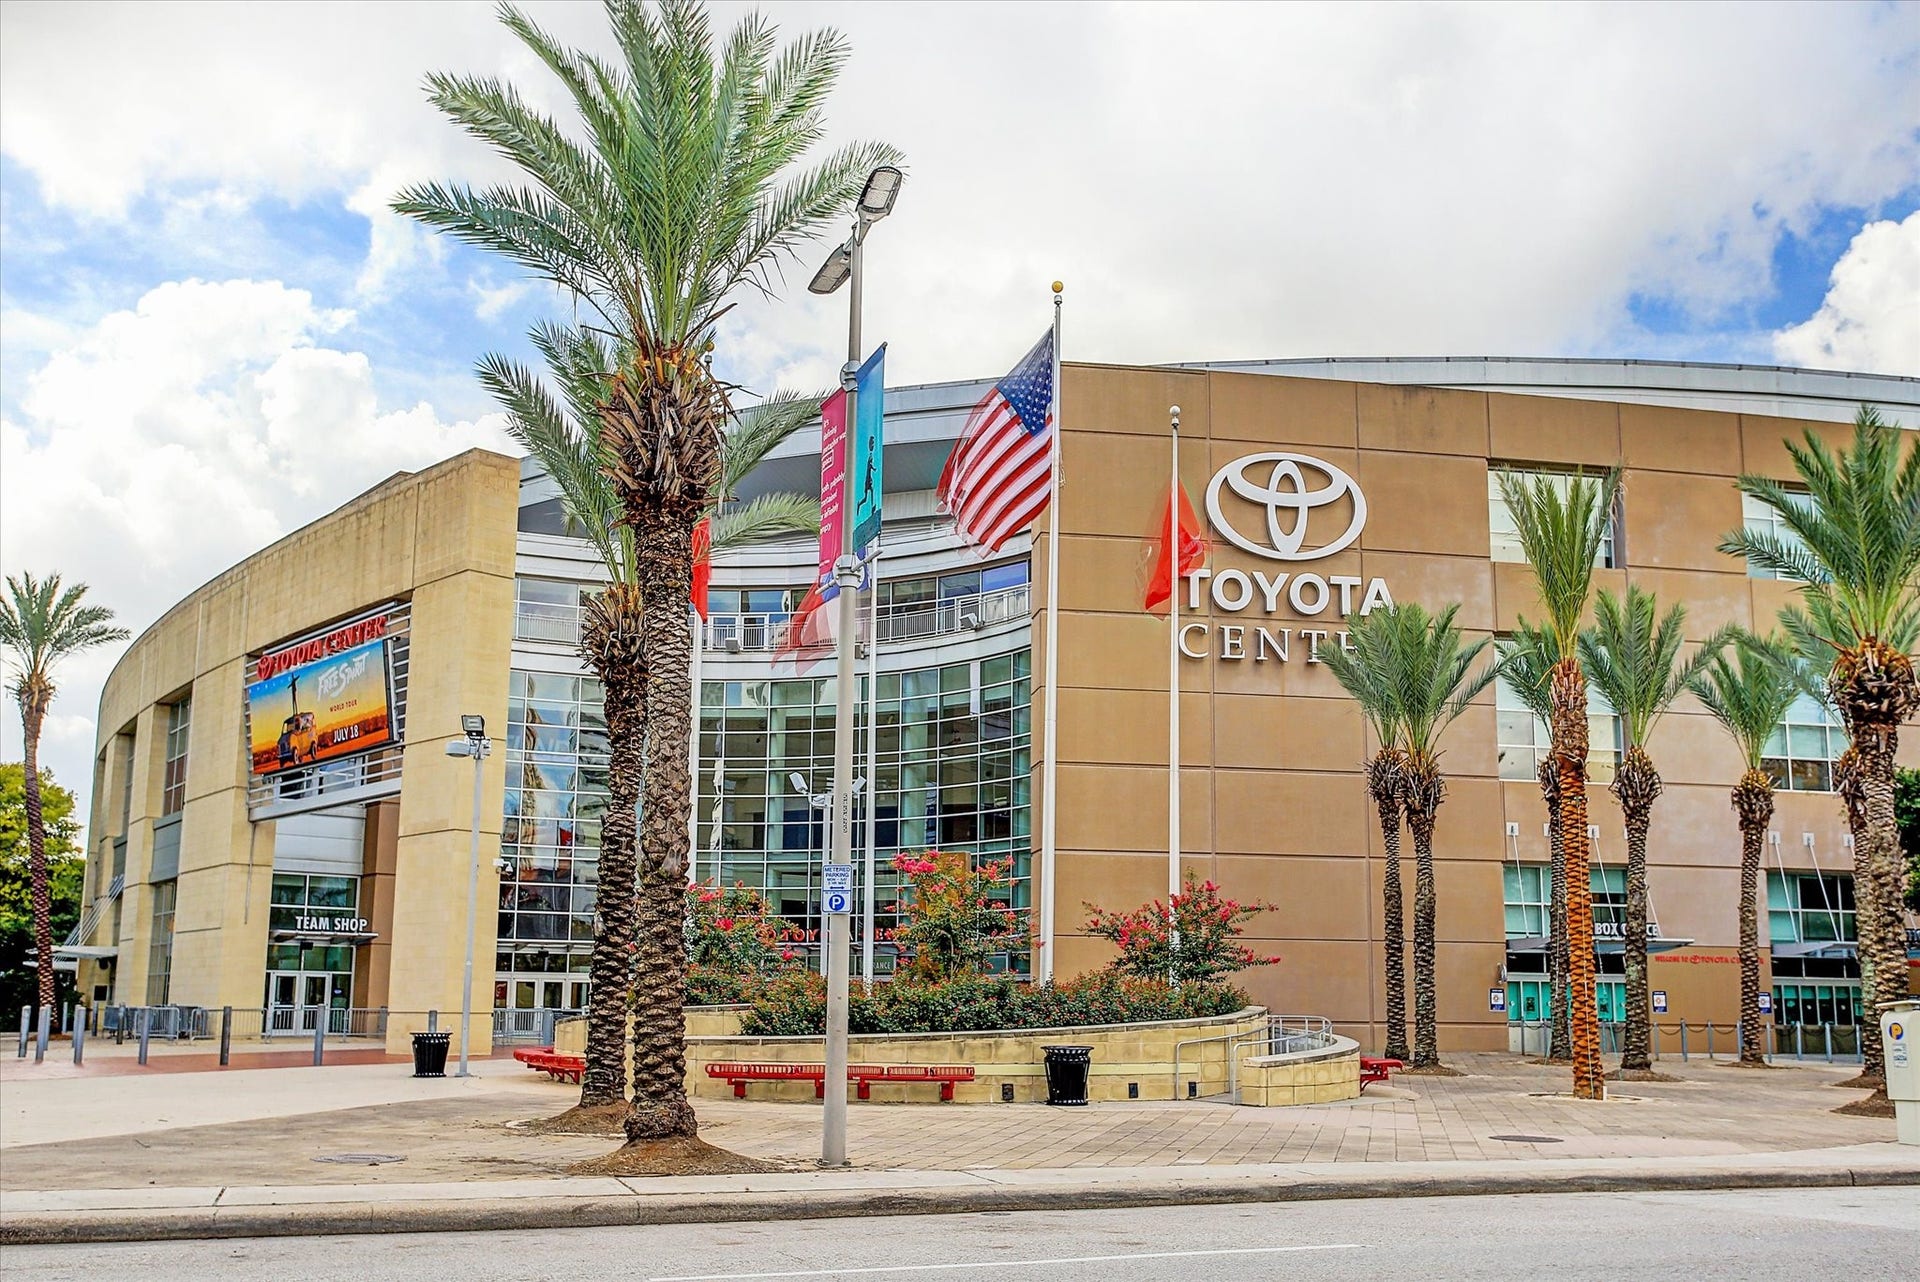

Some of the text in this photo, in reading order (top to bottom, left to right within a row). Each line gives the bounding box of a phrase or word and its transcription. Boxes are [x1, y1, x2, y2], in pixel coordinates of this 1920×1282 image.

[1181, 568, 1396, 618] TOYOTA
[274, 615, 387, 672] TOYOTA CENTER
[345, 699, 358, 709] TOUR
[333, 724, 359, 743] JULY 18
[832, 896, 841, 909] P
[295, 915, 368, 931] TEAM SHOP
[1594, 922, 1619, 935] BOX
[1700, 956, 1730, 964] TOYOTA
